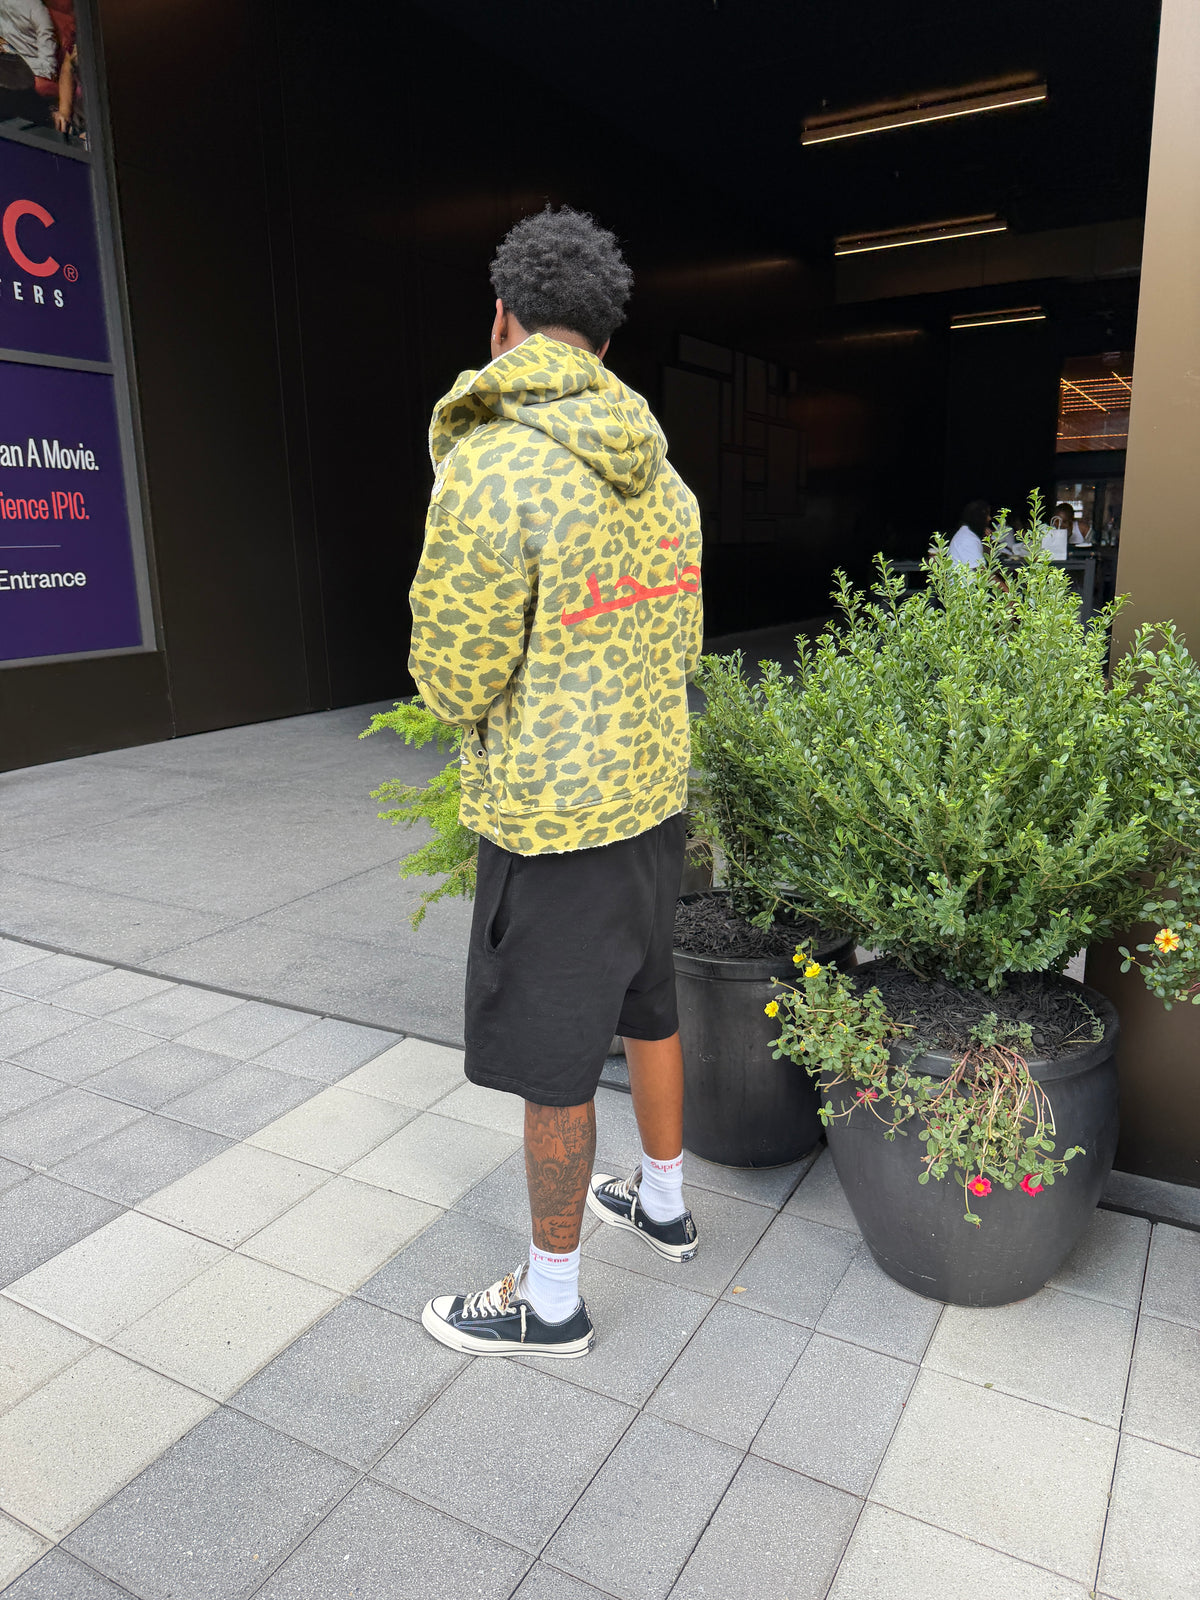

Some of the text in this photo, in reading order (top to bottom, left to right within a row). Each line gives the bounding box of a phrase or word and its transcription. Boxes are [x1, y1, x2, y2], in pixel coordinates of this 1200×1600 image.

[0, 279, 64, 308] ERS
[0, 438, 99, 471] an A Movie.
[0, 491, 90, 520] ience IPIC.
[0, 569, 87, 591] Entrance
